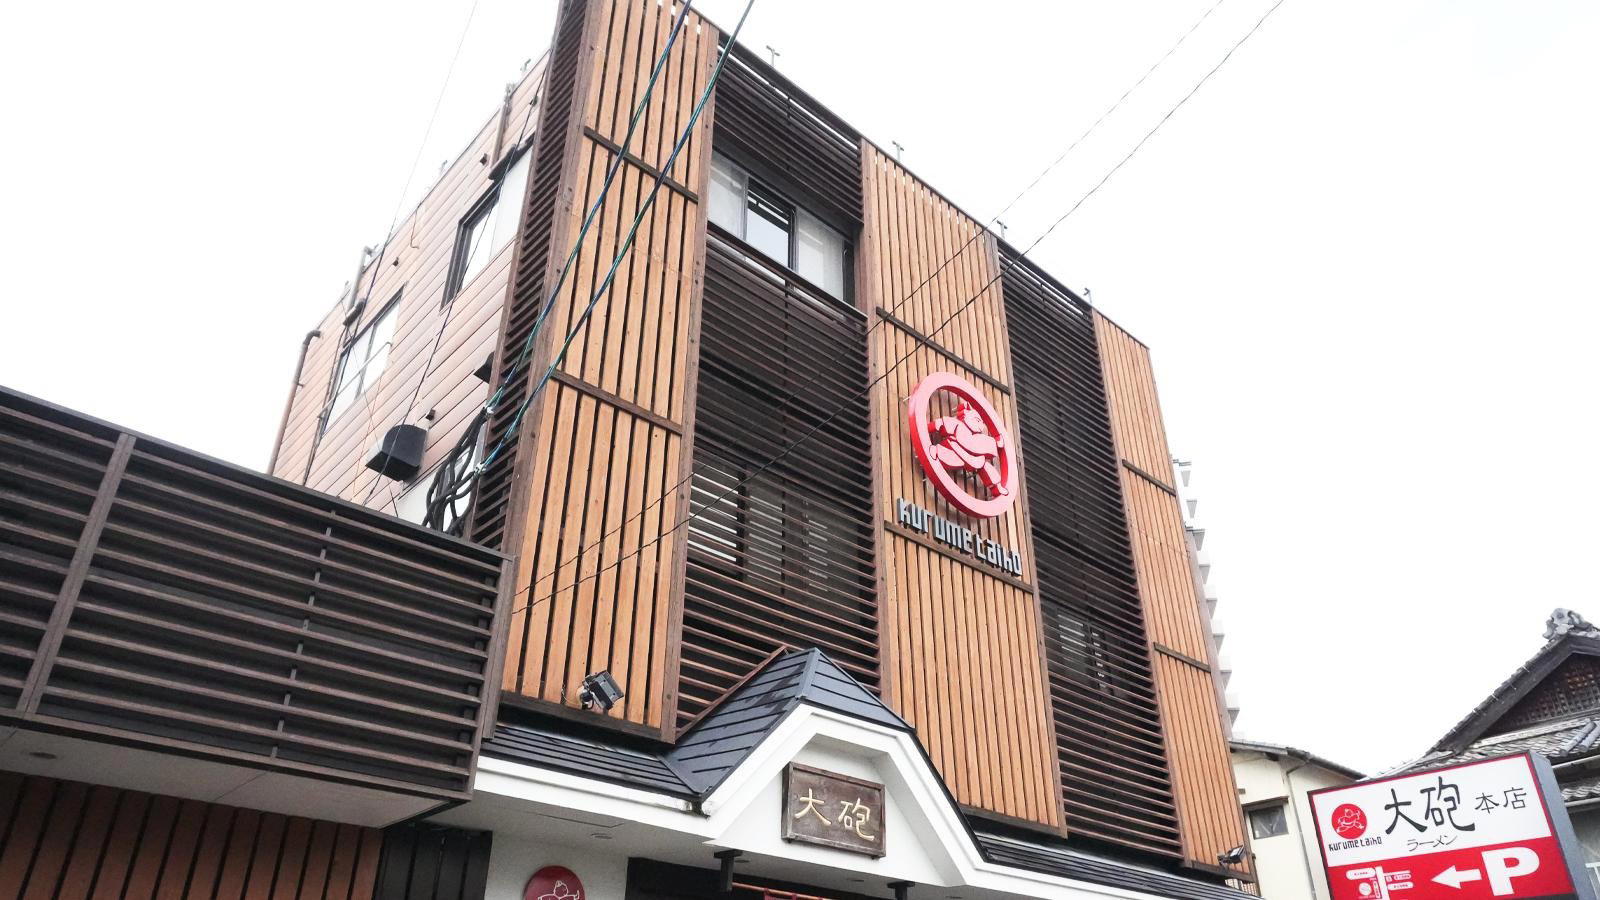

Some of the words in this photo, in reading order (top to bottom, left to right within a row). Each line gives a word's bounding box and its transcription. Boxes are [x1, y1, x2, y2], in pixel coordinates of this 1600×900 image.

[794, 787, 875, 842] 大砲
[1384, 776, 1476, 835] 大砲
[1474, 786, 1527, 815] 本店
[1407, 834, 1458, 852] ラーメン
[1481, 846, 1540, 897] P
